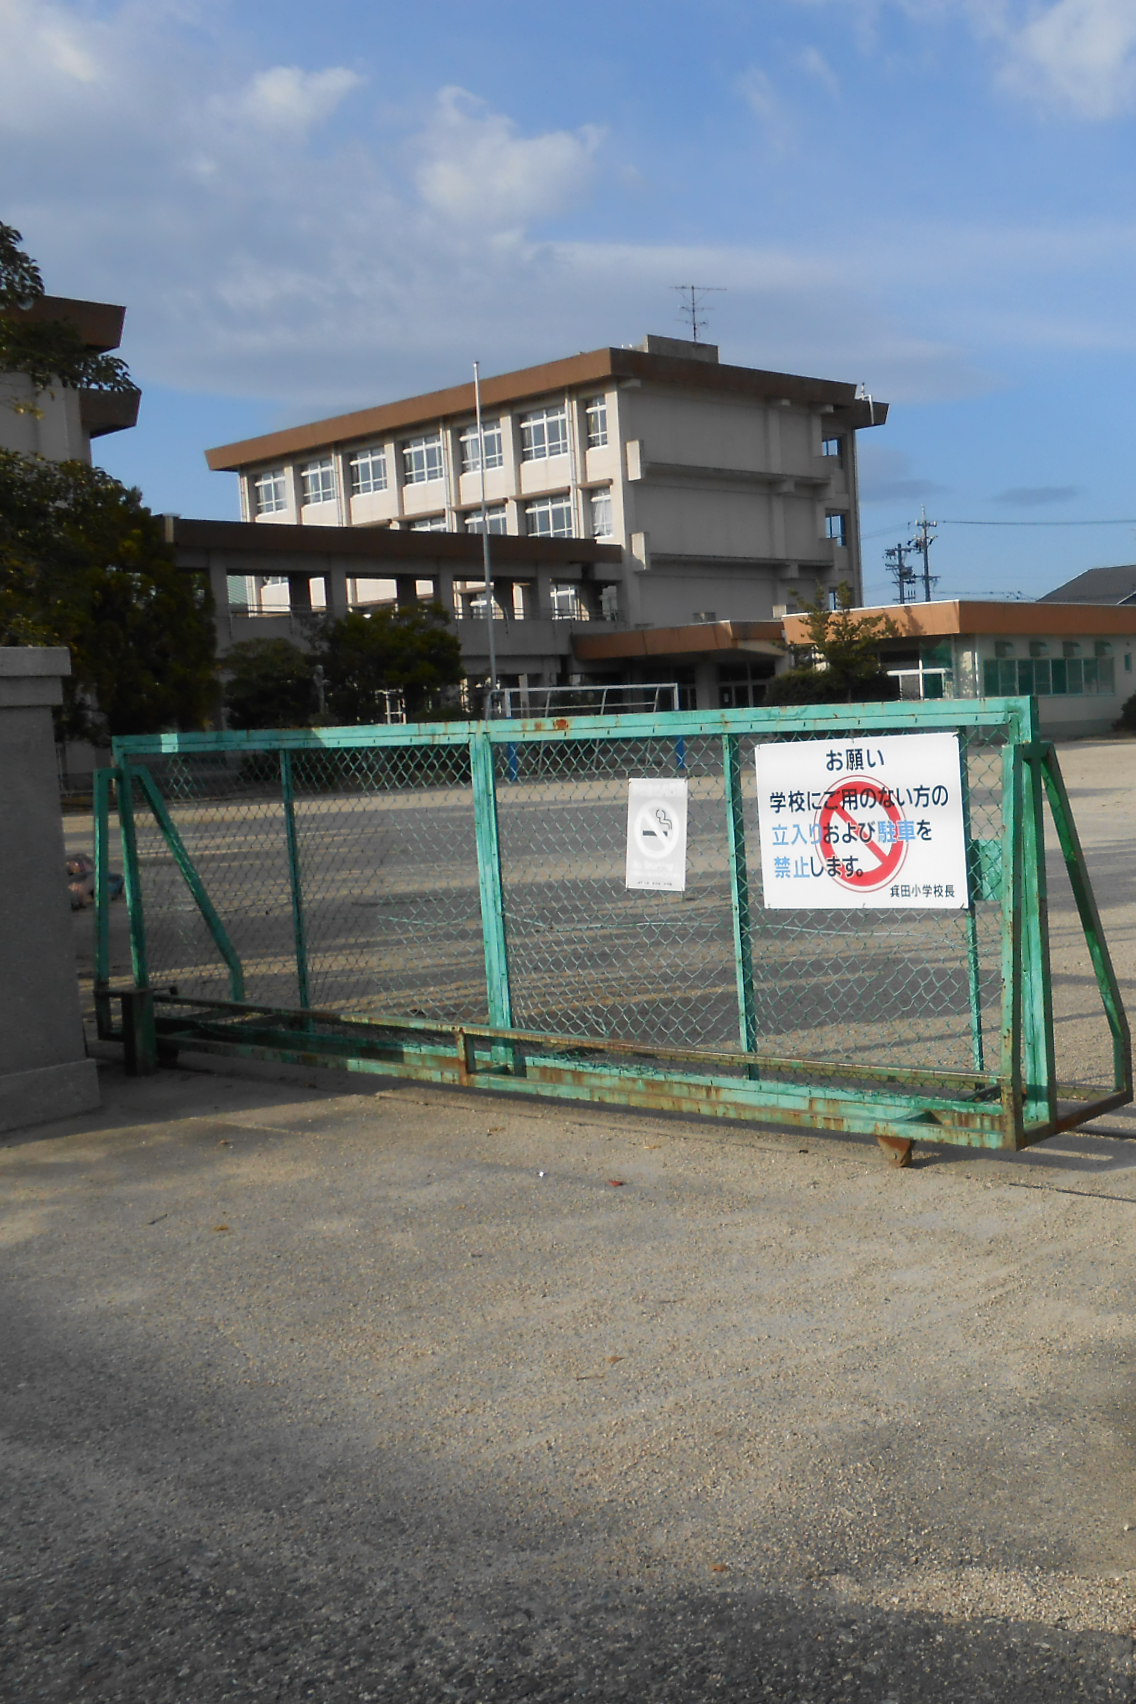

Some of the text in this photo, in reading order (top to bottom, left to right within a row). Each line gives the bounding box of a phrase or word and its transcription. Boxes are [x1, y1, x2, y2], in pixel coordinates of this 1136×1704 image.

[825, 748, 885, 771] お願い
[769, 784, 949, 813] 学校にご用のない方の
[772, 819, 932, 847] 立入りおよび駐車を
[774, 856, 865, 879] 禁止します。
